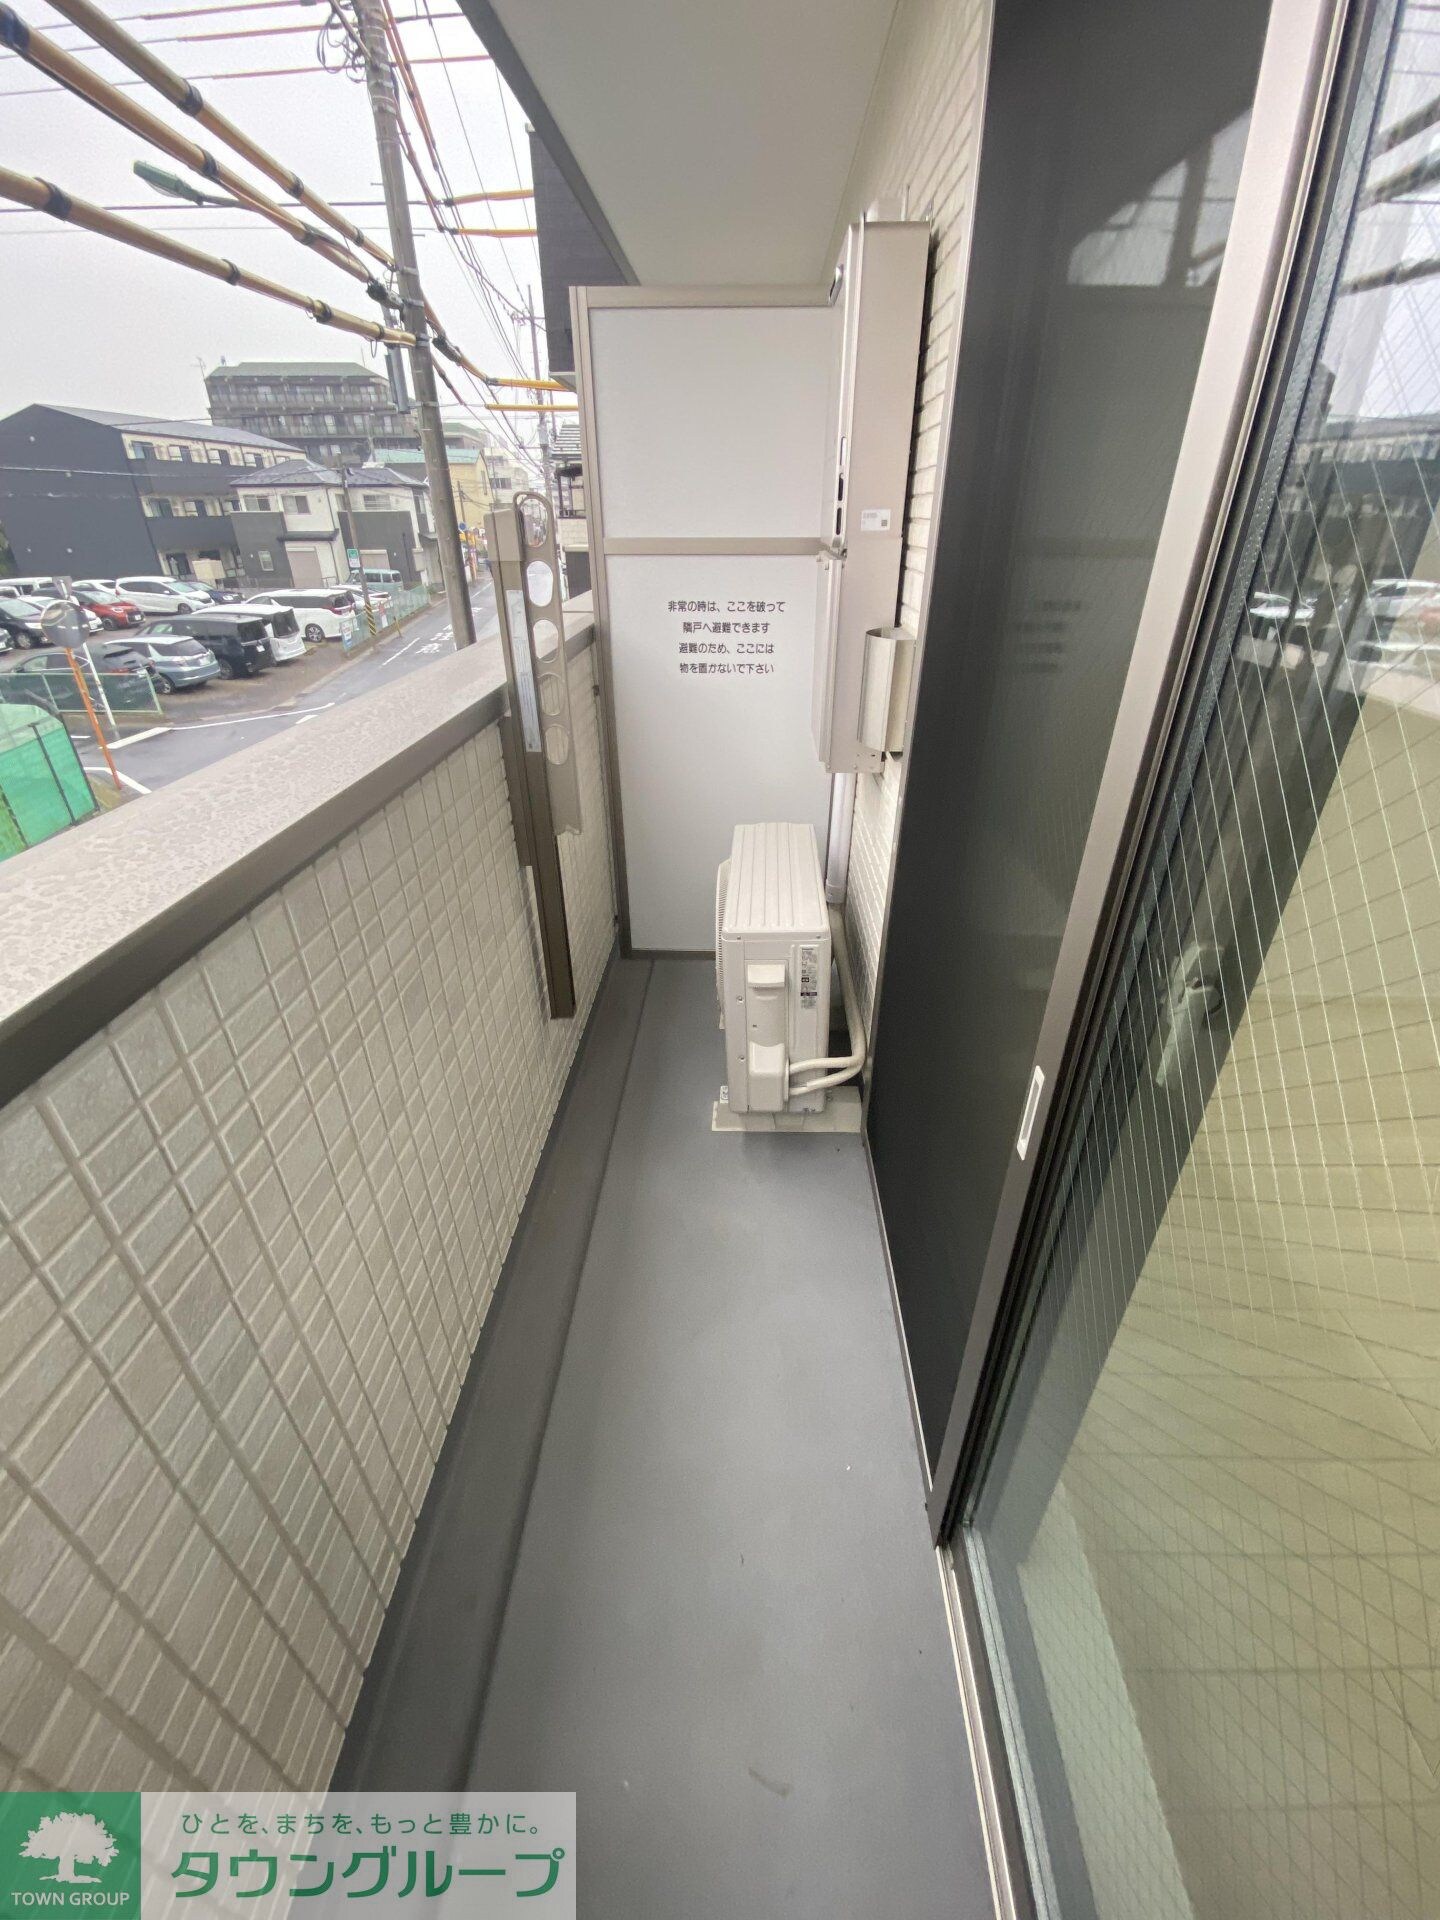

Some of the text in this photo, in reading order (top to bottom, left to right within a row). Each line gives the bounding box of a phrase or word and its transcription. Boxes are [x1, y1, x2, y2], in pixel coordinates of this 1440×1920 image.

[667, 600, 786, 613] 非常の時は、ここを破って
[682, 621, 771, 634] 隣戸へ避難できます
[678, 642, 775, 655] 避難のため、ここには
[679, 662, 775, 675] 物を置かないで下さい
